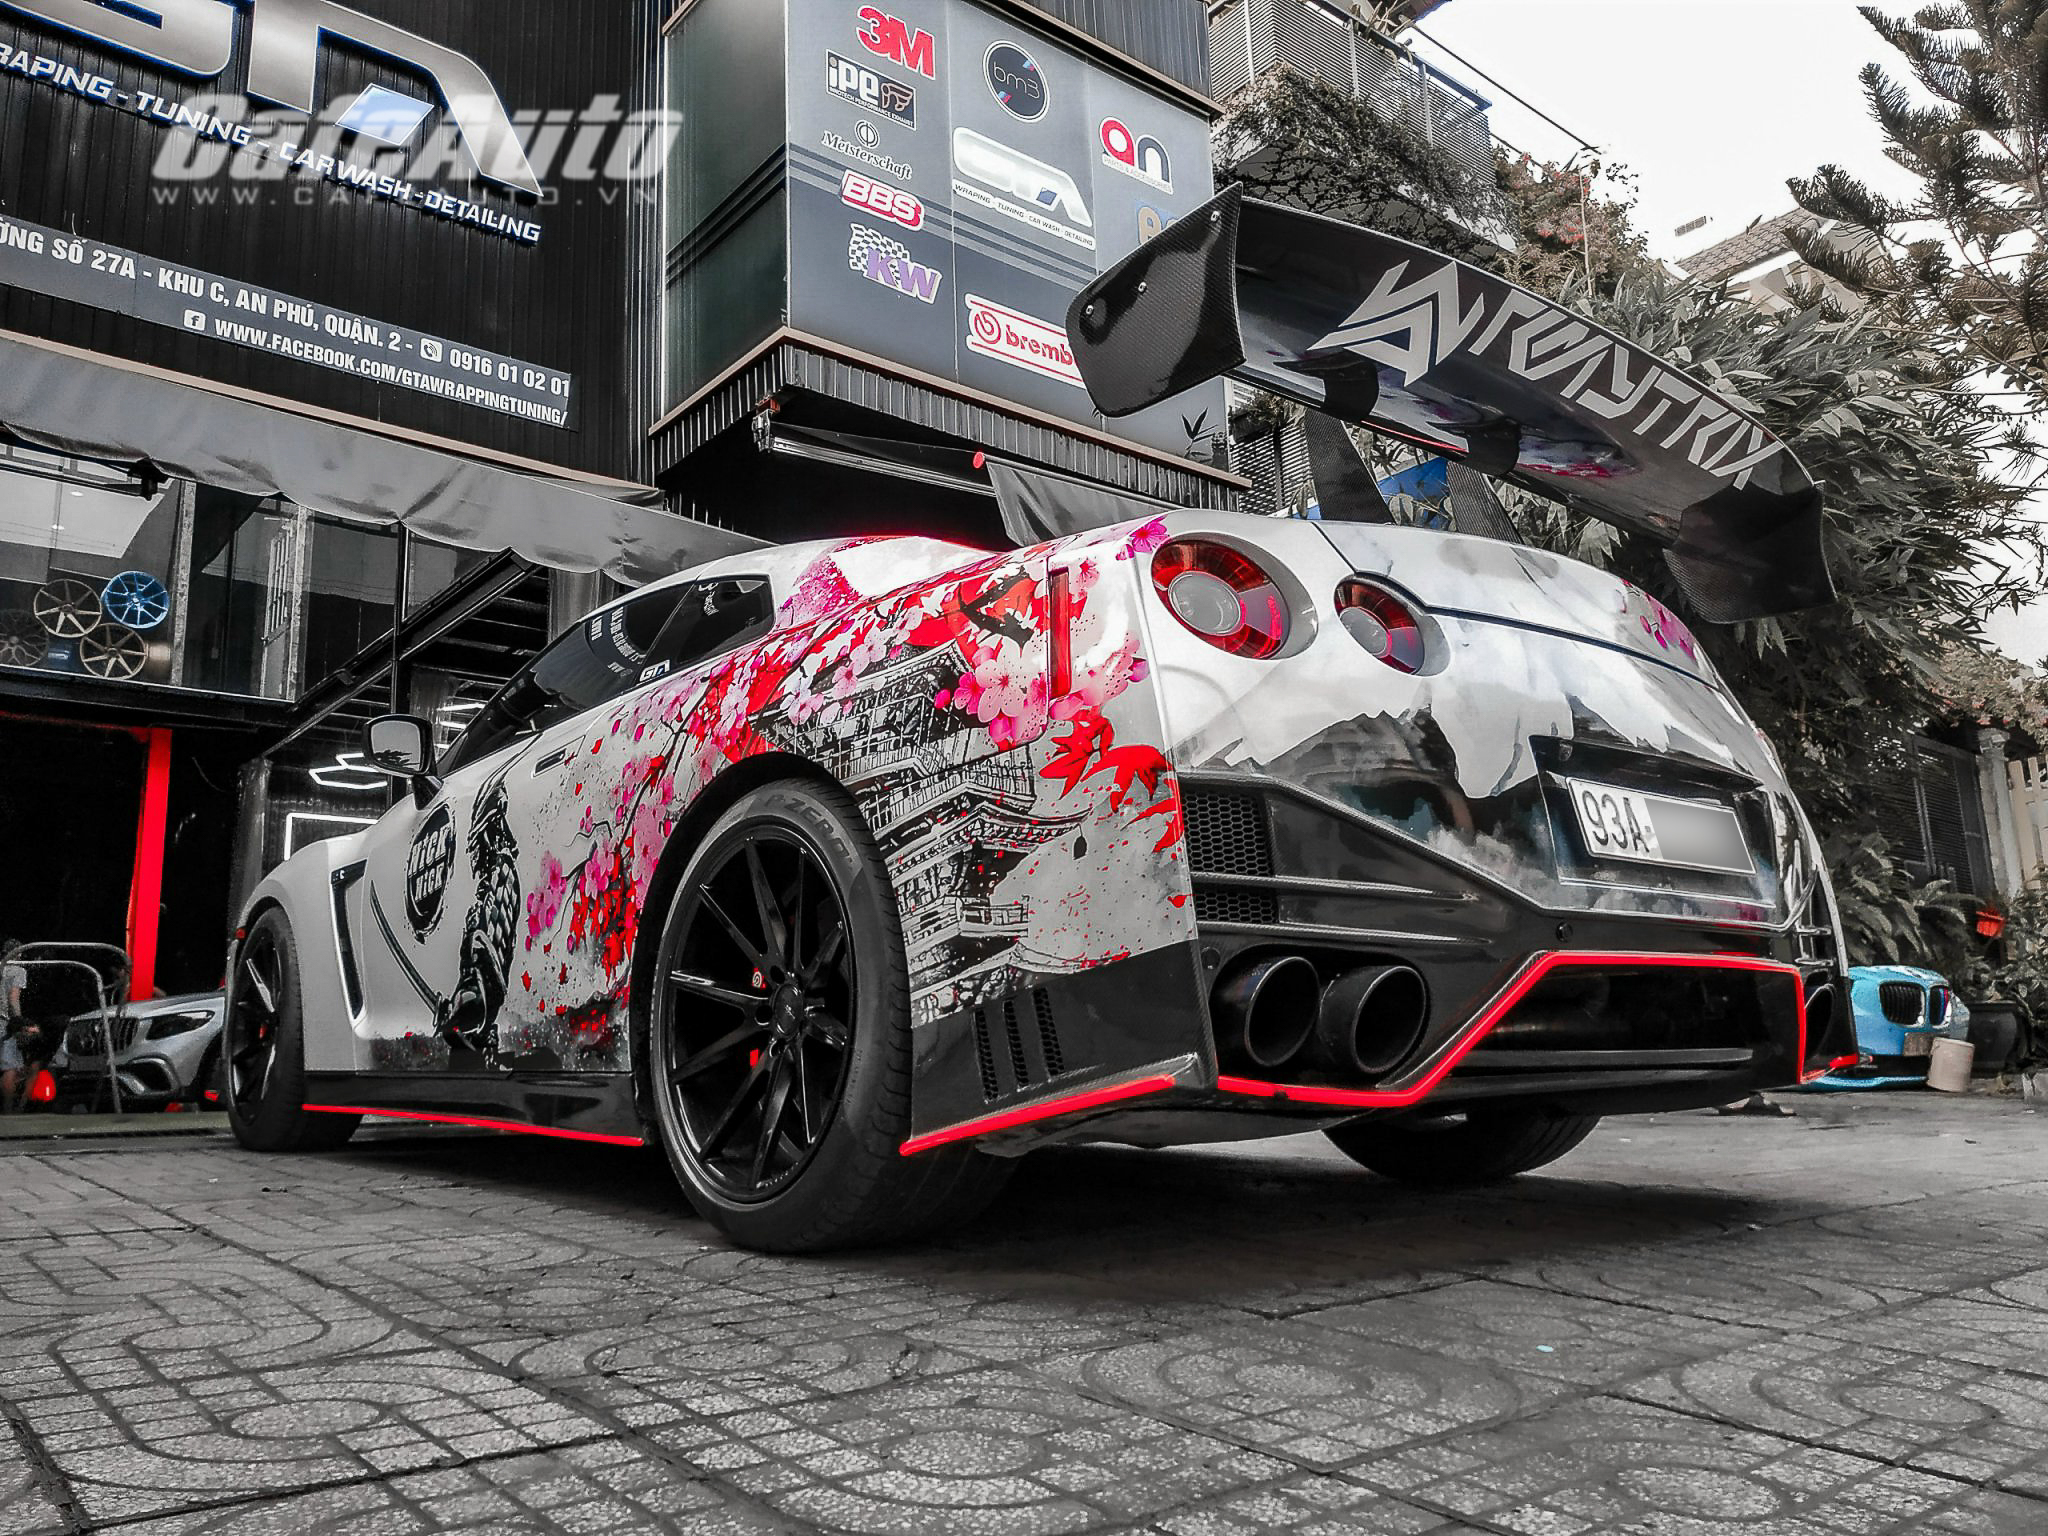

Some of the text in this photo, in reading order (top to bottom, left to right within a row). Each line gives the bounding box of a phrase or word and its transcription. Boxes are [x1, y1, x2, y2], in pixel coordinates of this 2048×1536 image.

[856, 6, 934, 79] 3M
[993, 61, 1040, 99] bm3
[137, 91, 251, 145] TUNING
[424, 190, 541, 242] DETAILING
[822, 130, 912, 180] Meisterschaft
[842, 172, 922, 228] BBS
[955, 184, 1094, 247] WRAPING TUNING CAR WASH DETAILING
[866, 246, 938, 300] KW
[52, 238, 87, 265] SỐ
[91, 249, 136, 280] 27A
[158, 267, 204, 298] KHU
[210, 282, 230, 308] C,
[235, 288, 267, 315] AN
[273, 298, 319, 331] PHÚ,
[324, 312, 384, 347] QUẬN.
[388, 331, 401, 352] 2
[450, 348, 493, 377] 0916
[498, 362, 518, 384] 01
[523, 368, 546, 391] 02
[550, 376, 570, 398] 01
[1006, 324, 1077, 366] bremb
[215, 318, 568, 426] WWW.FACEBOOK.COM/GTAWRAPPINGTUNING/
